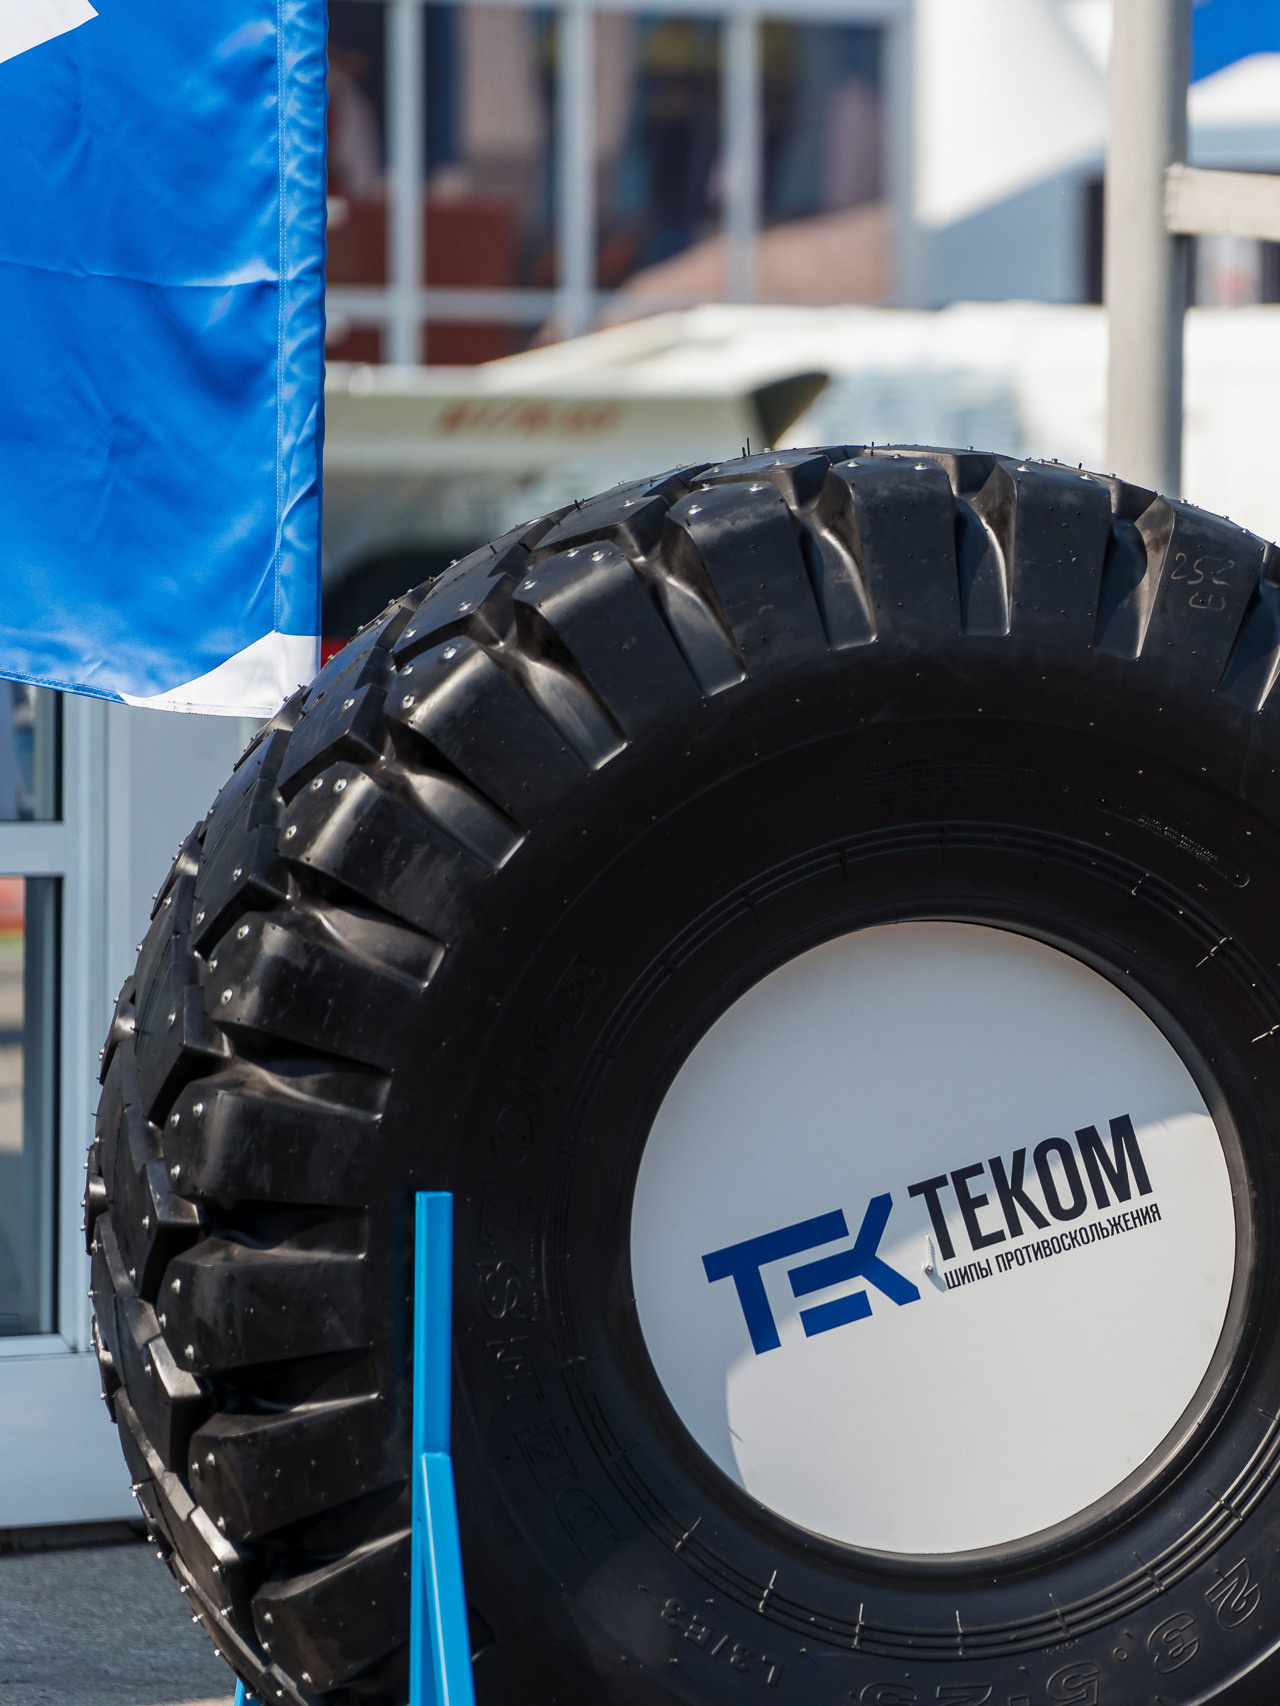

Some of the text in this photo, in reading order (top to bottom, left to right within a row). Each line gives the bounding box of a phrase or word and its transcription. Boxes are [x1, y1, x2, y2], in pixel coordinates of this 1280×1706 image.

[1170, 552, 1235, 587] 252
[907, 1113, 1153, 1261] ТЕКОМ
[944, 1203, 1162, 1290] ШИПЫ ПРОТИВОСКОЛЬЖЕНИЯ
[660, 1597, 784, 1688] L3/E3
